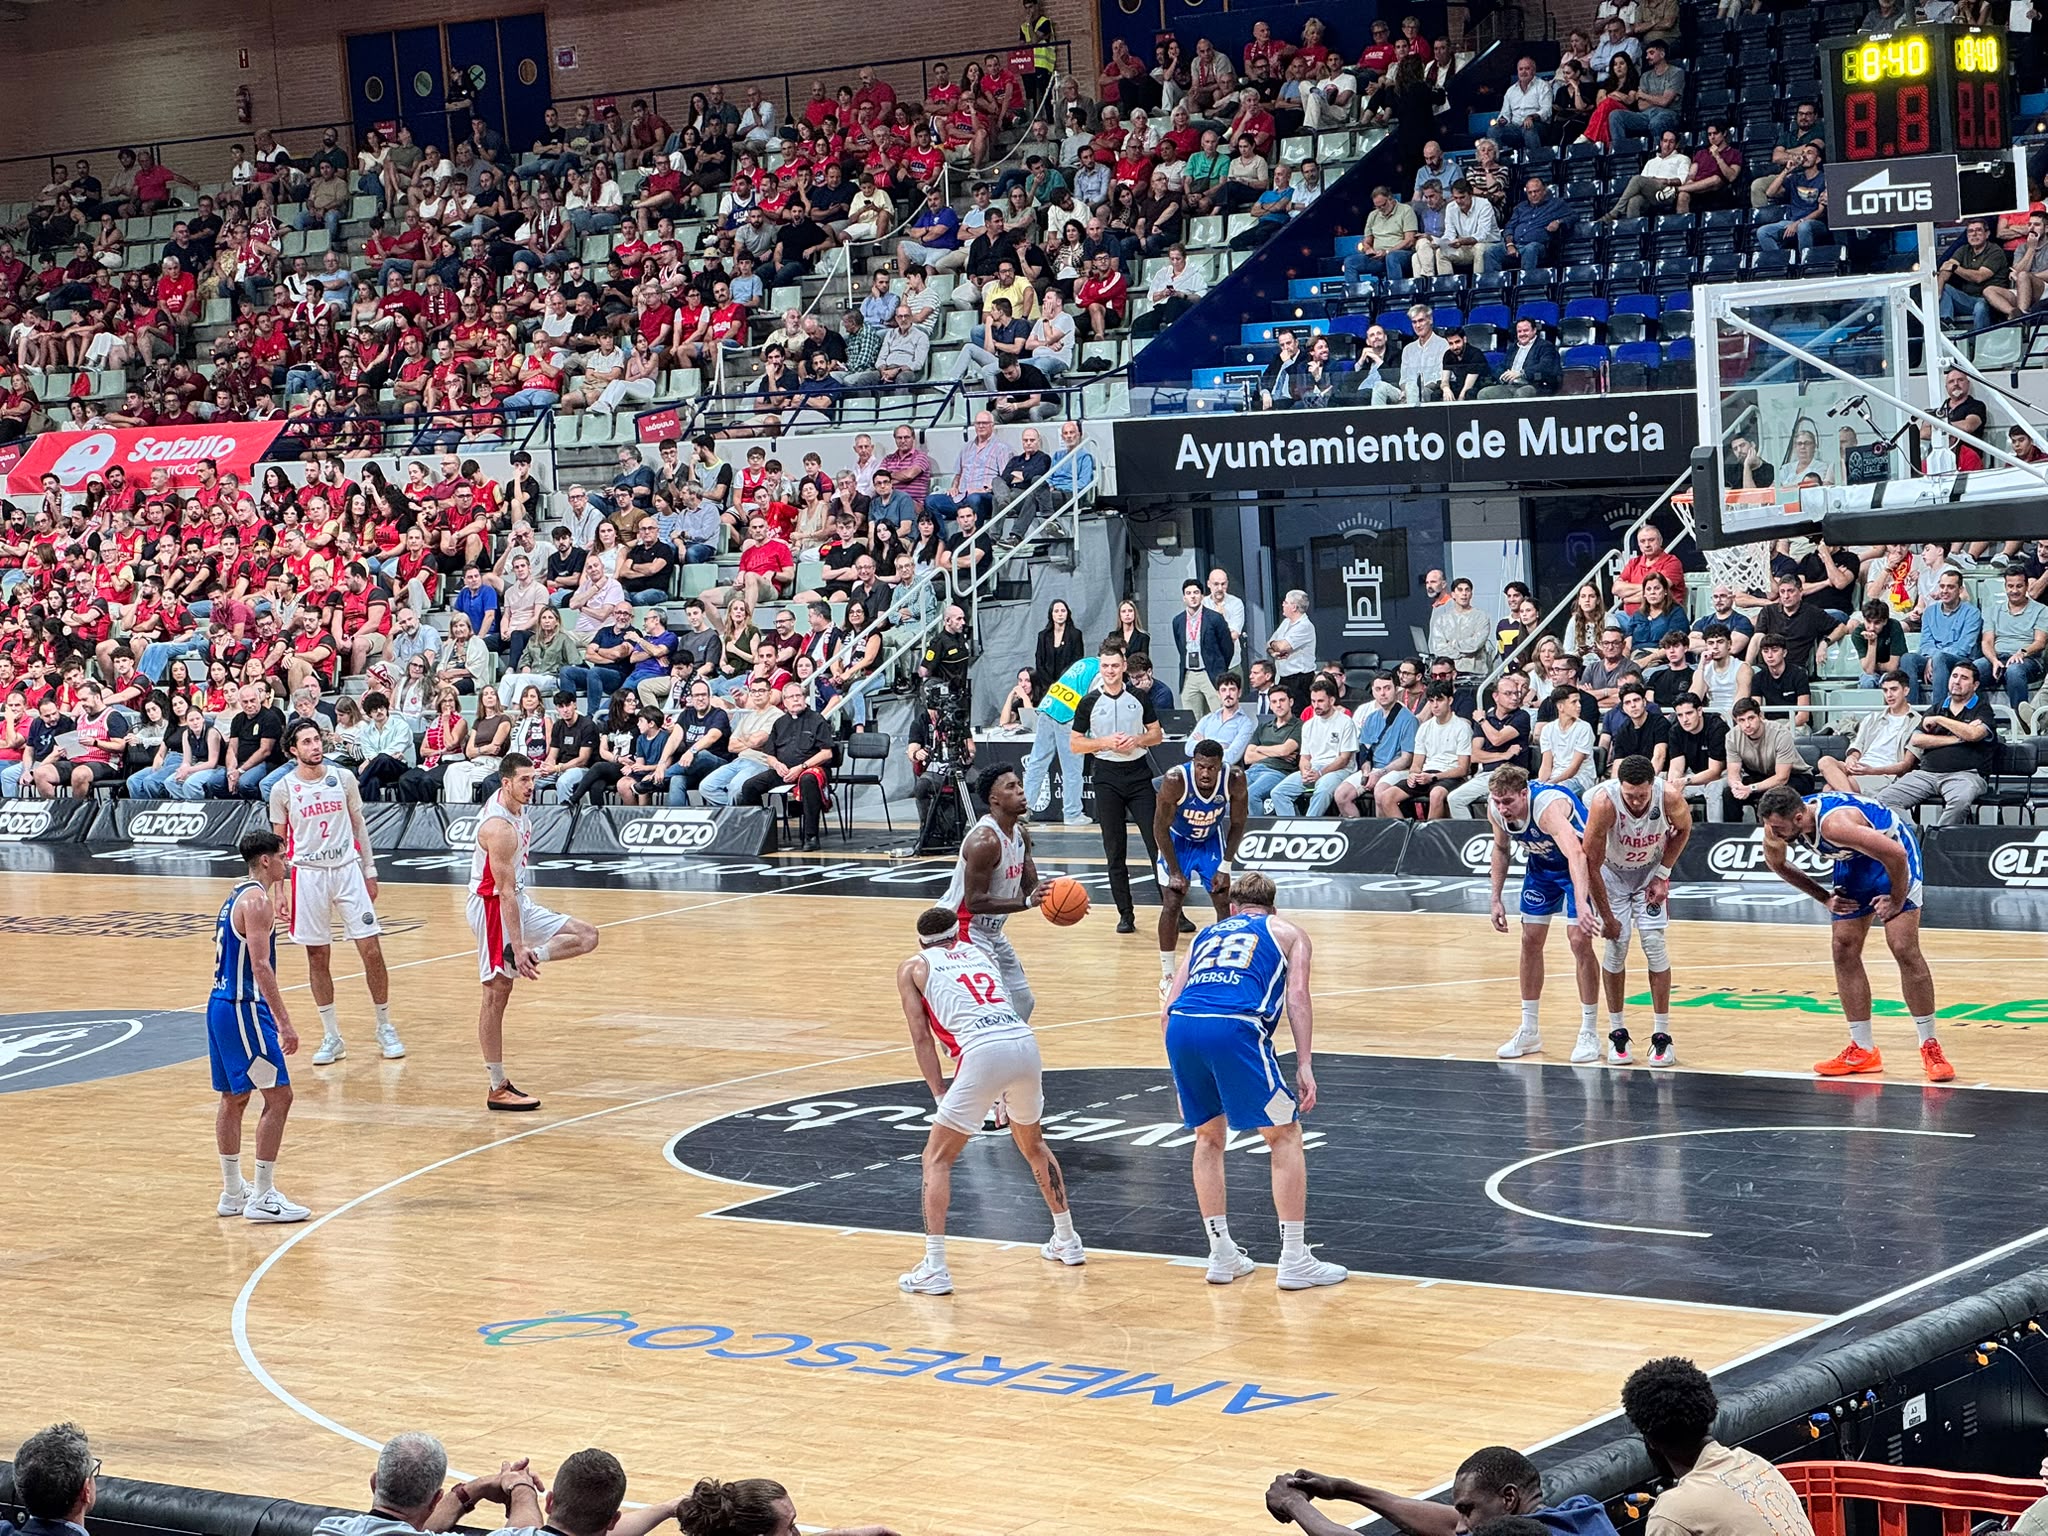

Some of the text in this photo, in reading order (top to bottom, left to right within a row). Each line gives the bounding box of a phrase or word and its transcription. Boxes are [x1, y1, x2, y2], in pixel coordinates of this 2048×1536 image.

[1846, 189, 1933, 216] LOTUS
[645, 420, 675, 432] MÓDULO
[128, 434, 236, 462] Salzillo
[1175, 411, 1665, 478] Ayuntamiento de Murcia
[1050, 684, 1075, 702] OTO
[300, 801, 343, 818] VARESE
[0, 815, 48, 835] POZO
[320, 821, 329, 838] 2
[1190, 827, 1210, 839] 31
[1625, 851, 1647, 862] 22
[1191, 933, 1258, 974] 28
[956, 972, 1006, 1006] 12
[627, 1325, 1338, 1414] AMERESCO
